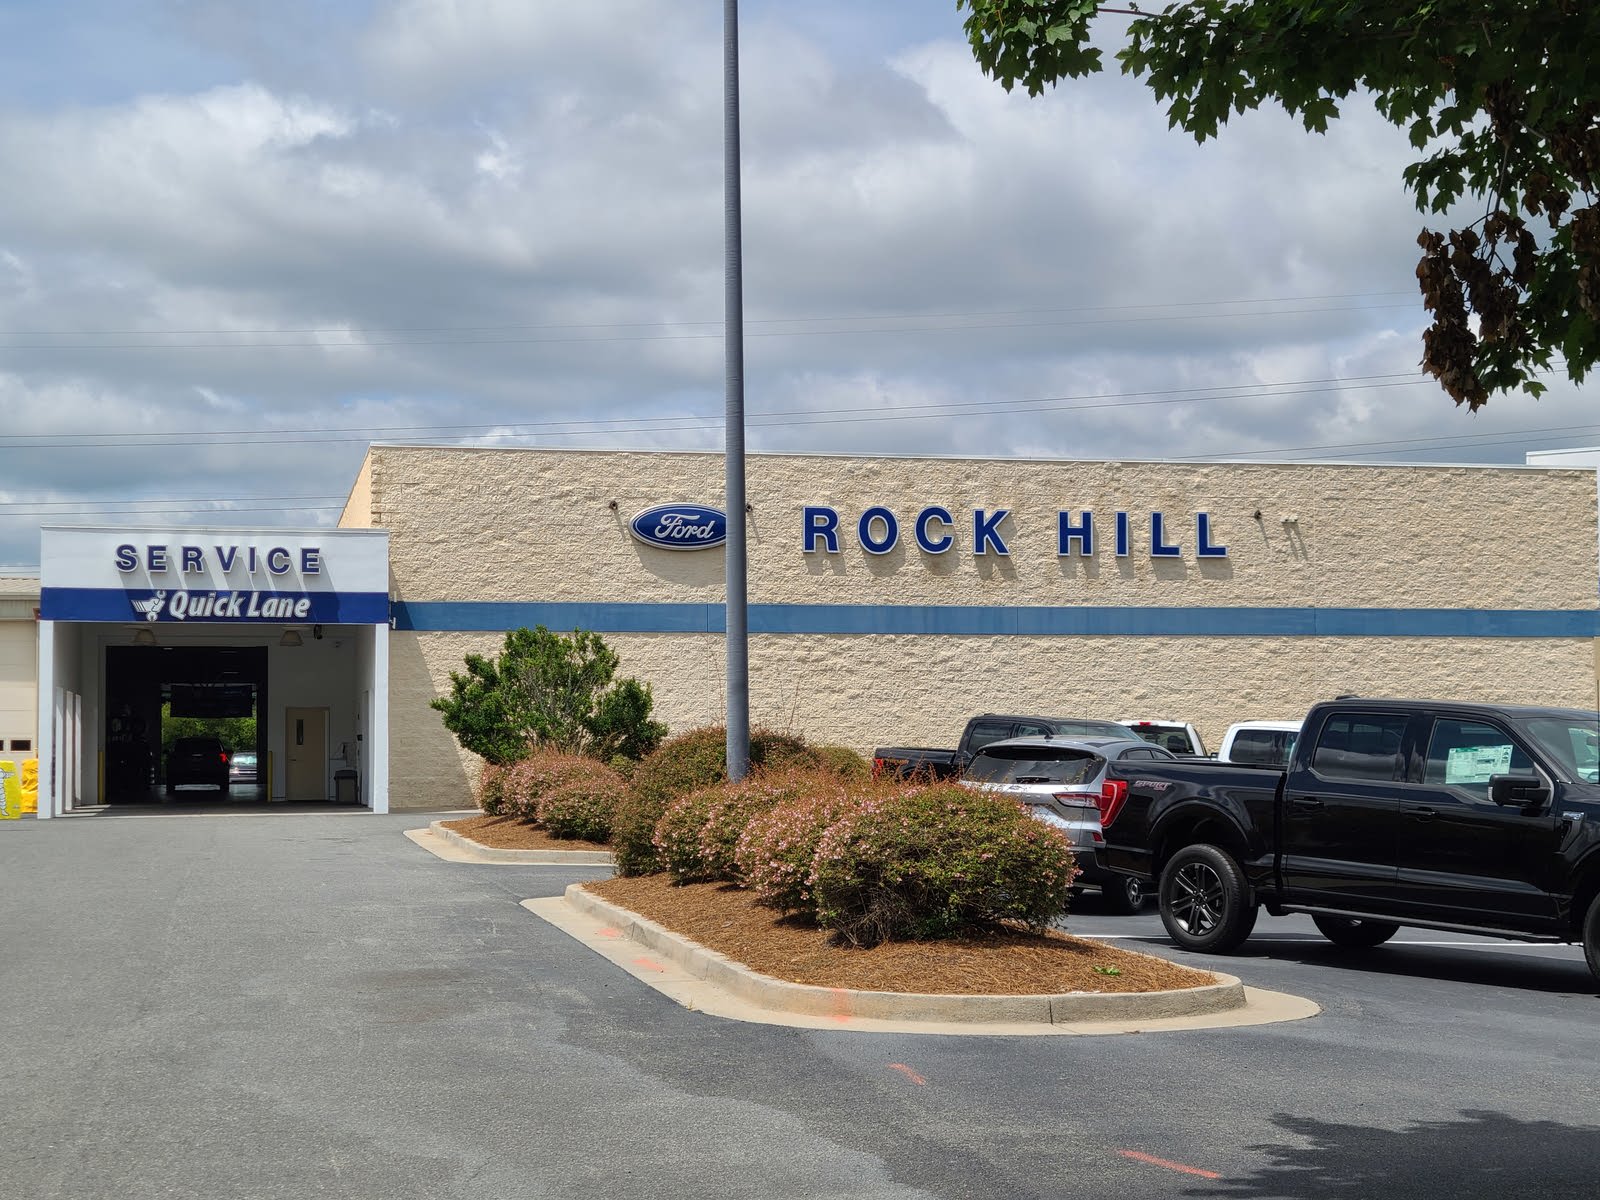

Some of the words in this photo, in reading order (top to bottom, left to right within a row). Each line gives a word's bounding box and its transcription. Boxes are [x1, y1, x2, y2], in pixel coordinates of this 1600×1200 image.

[654, 513, 716, 539] Ford
[802, 505, 1011, 555] ROCK
[1058, 510, 1229, 558] HILL
[115, 543, 321, 575] SERVICE
[168, 591, 245, 620] Quick
[246, 591, 311, 618] Lane
